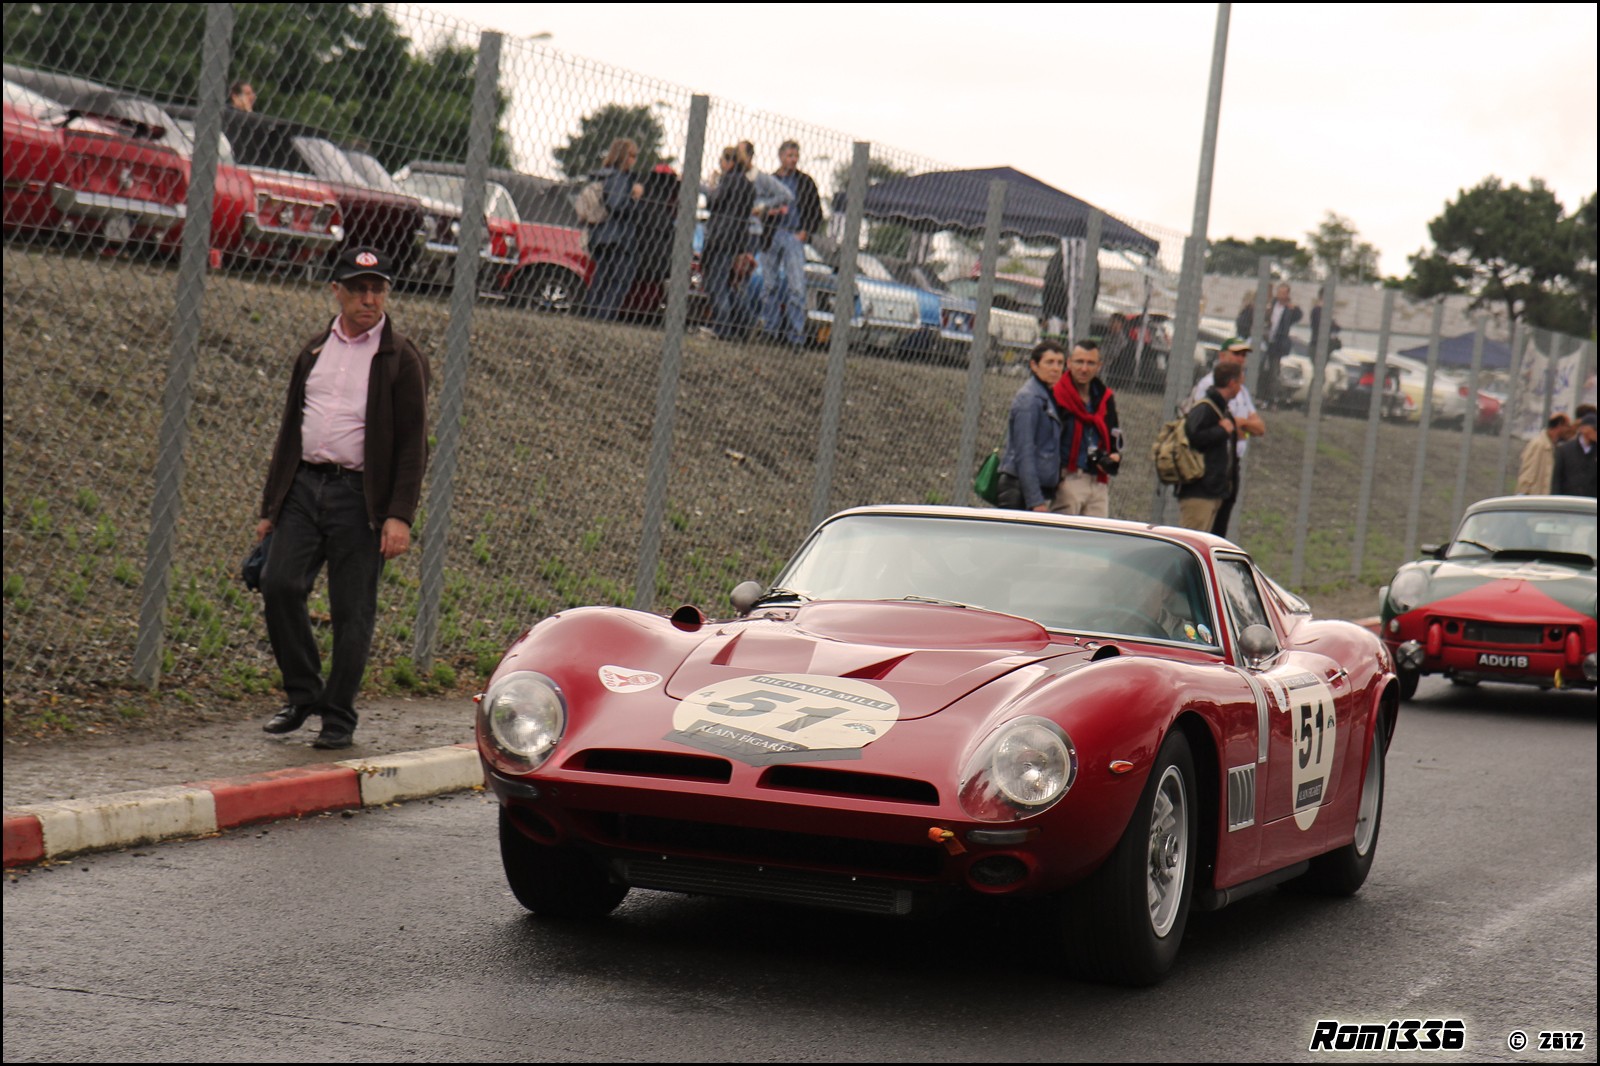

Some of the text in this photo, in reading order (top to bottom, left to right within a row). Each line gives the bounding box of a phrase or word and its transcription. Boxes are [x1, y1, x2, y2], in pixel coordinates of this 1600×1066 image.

[1478, 653, 1529, 668] ADU1B
[705, 689, 851, 733] 51
[755, 676, 891, 711] RICHARD MILLE
[699, 724, 737, 739] ALAIN
[1298, 699, 1325, 770] 51
